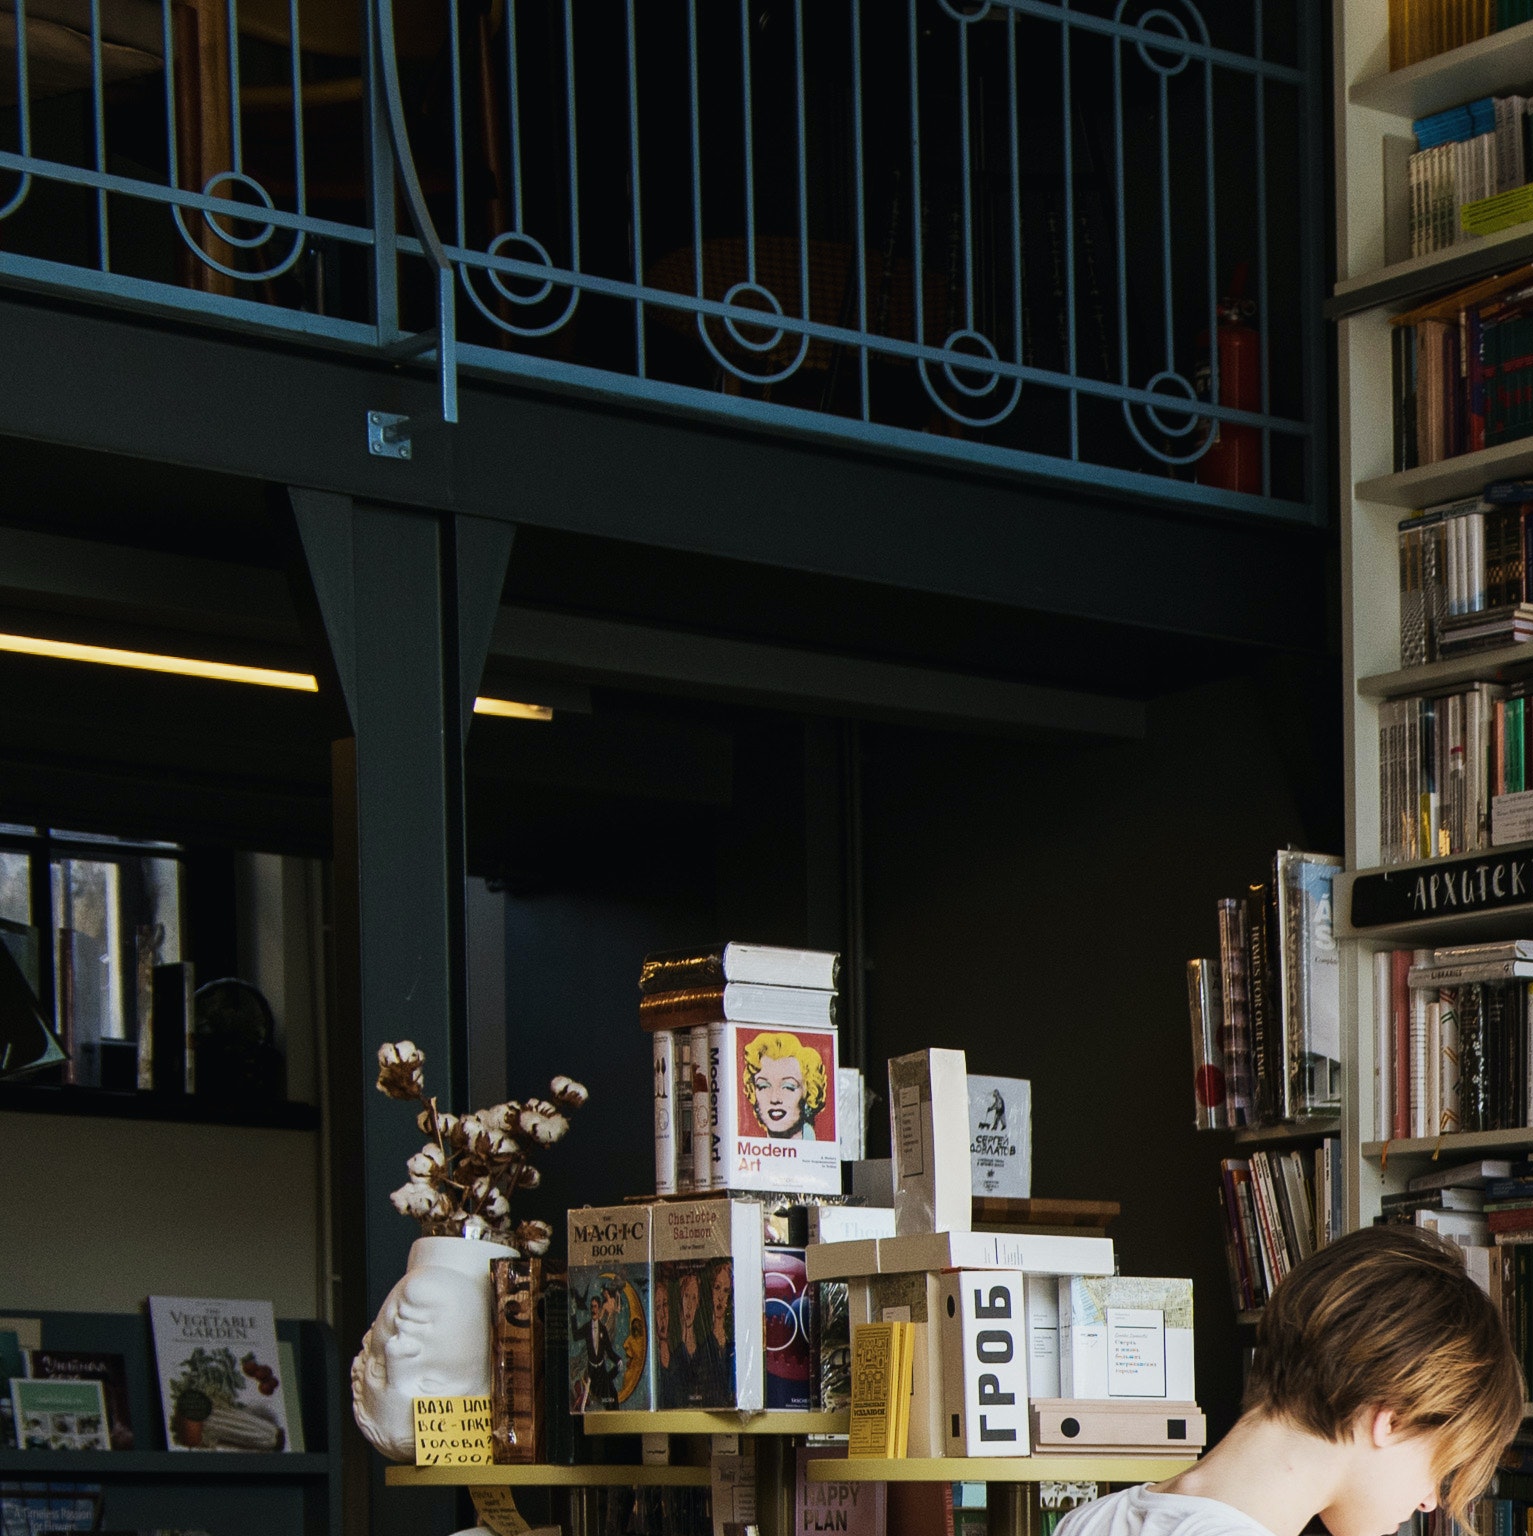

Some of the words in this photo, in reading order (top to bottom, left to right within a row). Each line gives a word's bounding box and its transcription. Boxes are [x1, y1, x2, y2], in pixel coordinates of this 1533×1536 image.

[737, 1141, 797, 1158] Modern
[738, 1159, 761, 1172] Art
[668, 1211, 717, 1225] Charlotte
[673, 1226, 712, 1241] Salomon
[591, 1244, 624, 1257] BOOK
[974, 1282, 1018, 1446] ГРОБ
